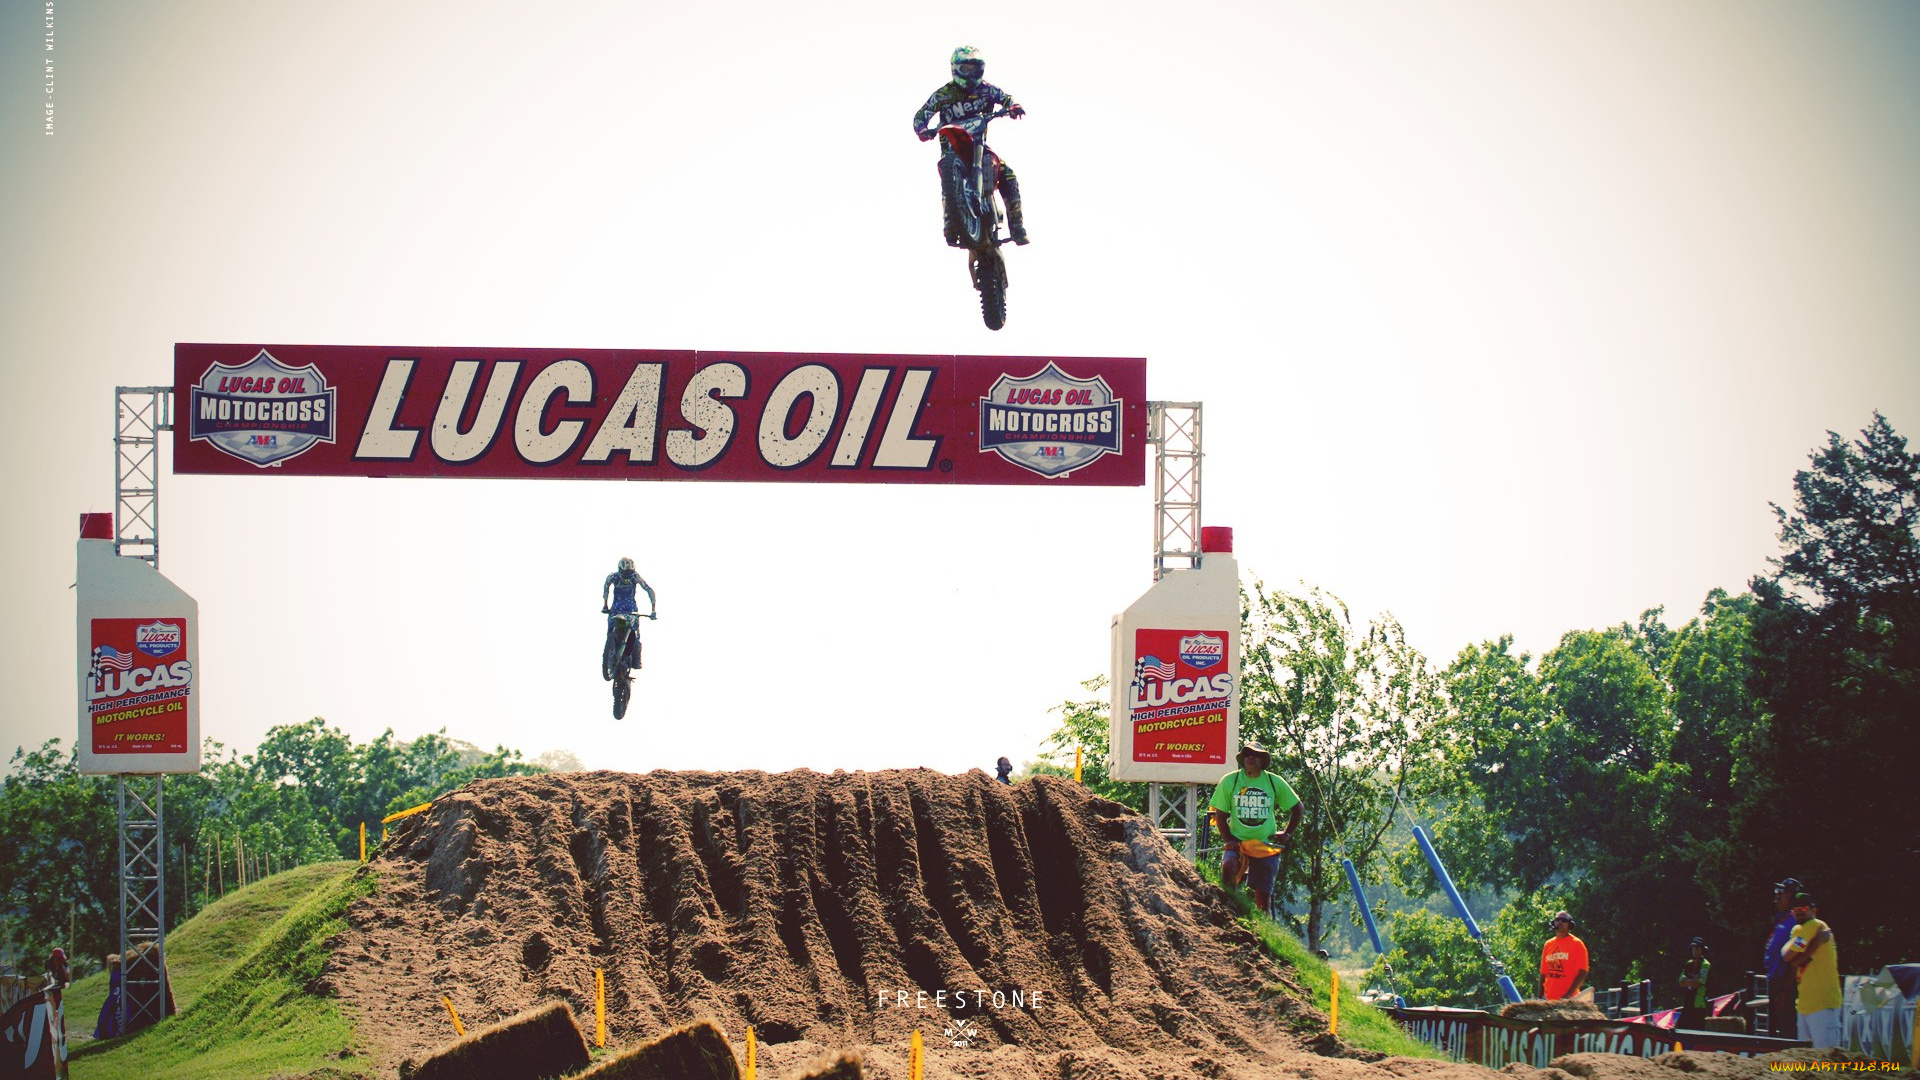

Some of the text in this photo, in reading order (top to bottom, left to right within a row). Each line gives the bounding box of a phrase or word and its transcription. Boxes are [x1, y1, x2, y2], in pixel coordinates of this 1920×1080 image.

[217, 377, 306, 394] LUCAS OIL
[1006, 388, 1093, 406] LUCAS OIL
[200, 396, 326, 422] MOTOCROSS
[355, 359, 938, 469] LUCAS OIL
[989, 408, 1113, 433] MOTOCROSS
[246, 435, 277, 447] AMA
[1005, 433, 1096, 441] CHAMPIONSHIP
[1034, 446, 1066, 457] AMA
[141, 633, 178, 642] LUCAS
[1185, 645, 1220, 654] LUCAS
[86, 661, 192, 701] LUCAS
[88, 688, 191, 713] HIGH PERFORMANCE
[1128, 673, 1234, 711] LUCAS
[96, 702, 184, 724] MOTORCYCLE OIL
[1130, 700, 1231, 721] HIGH PERFORMANCE
[1138, 714, 1223, 733] MOTORCYCLE OIL
[114, 733, 165, 741] IT WORKS!
[1166, 743, 1205, 751] WORKS!
[1233, 795, 1271, 807] TRACK
[1236, 807, 1270, 818] CREW
